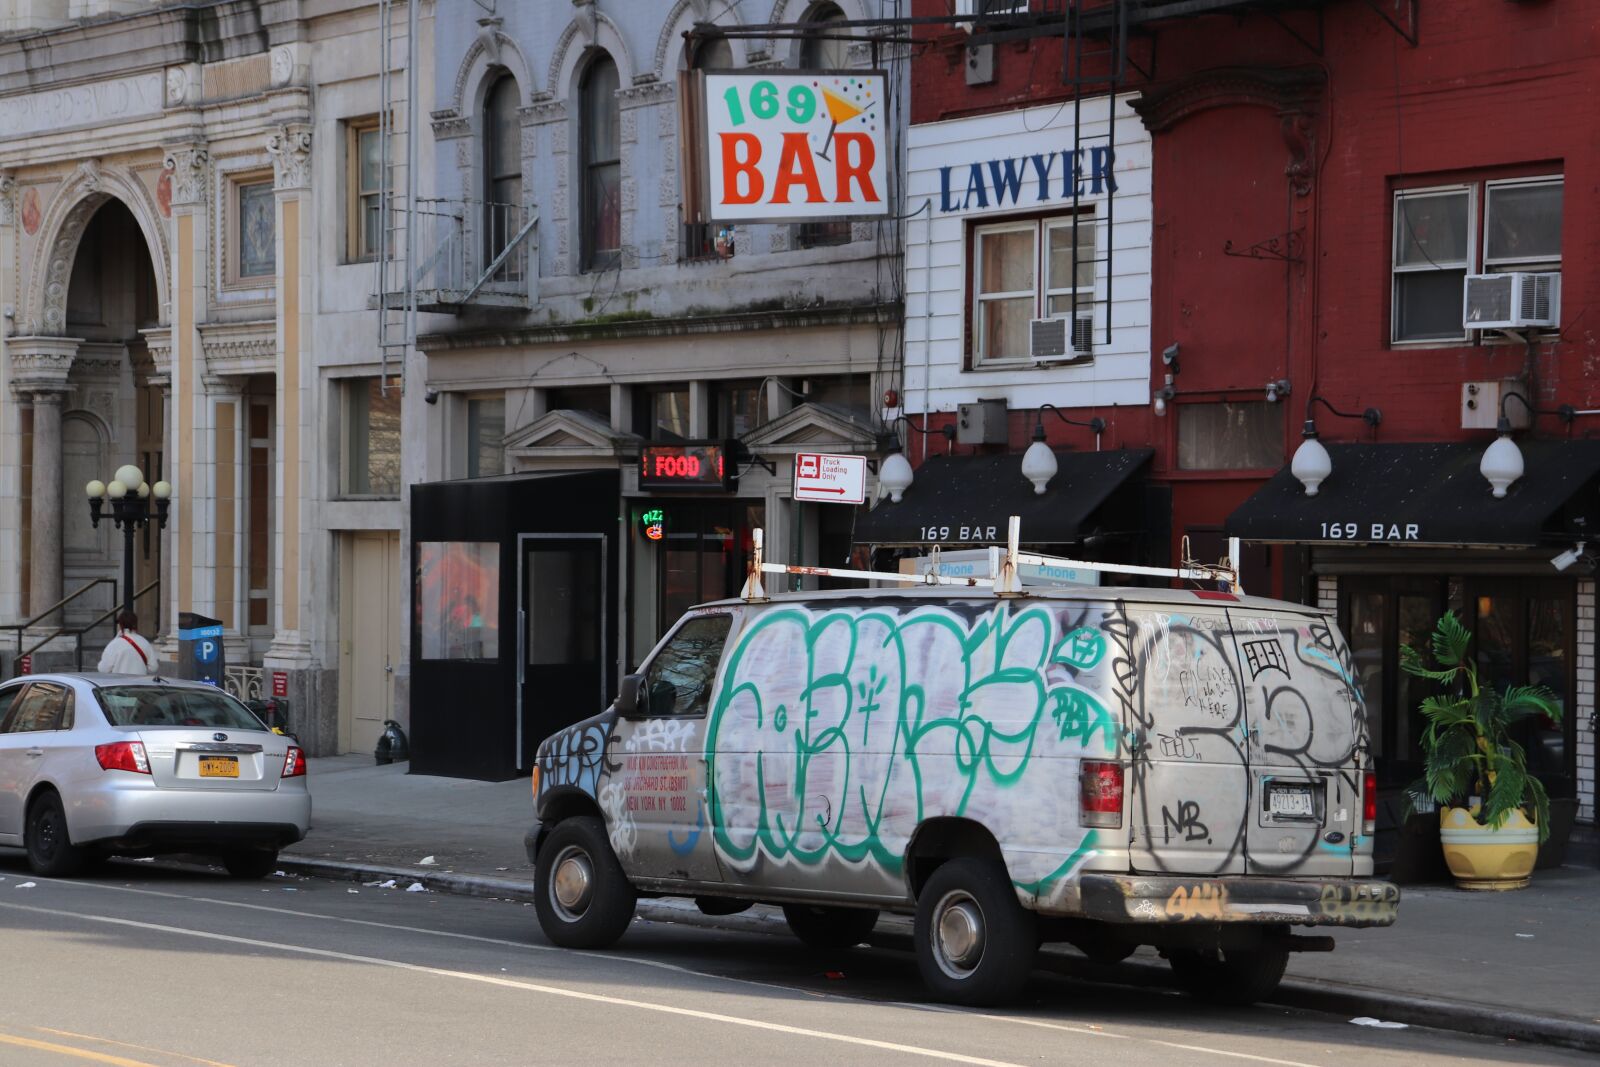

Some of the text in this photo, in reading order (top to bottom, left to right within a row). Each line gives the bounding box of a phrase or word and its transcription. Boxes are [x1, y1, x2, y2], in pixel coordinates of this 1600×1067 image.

[723, 80, 817, 127] 169
[717, 132, 882, 205] BAR
[938, 144, 1119, 213] LAWYER
[655, 456, 700, 477] FOOD
[823, 457, 841, 466] Truck
[821, 472, 837, 481] Only
[822, 465, 848, 475] Loading
[921, 526, 997, 541] 169 BAR
[1321, 522, 1419, 540] 169 BAR
[939, 563, 975, 578] Phone
[1038, 566, 1077, 581] Phone
[202, 641, 214, 660] P
[626, 796, 638, 811] NEW
[641, 796, 656, 811] YORK
[658, 796, 666, 811] NY
